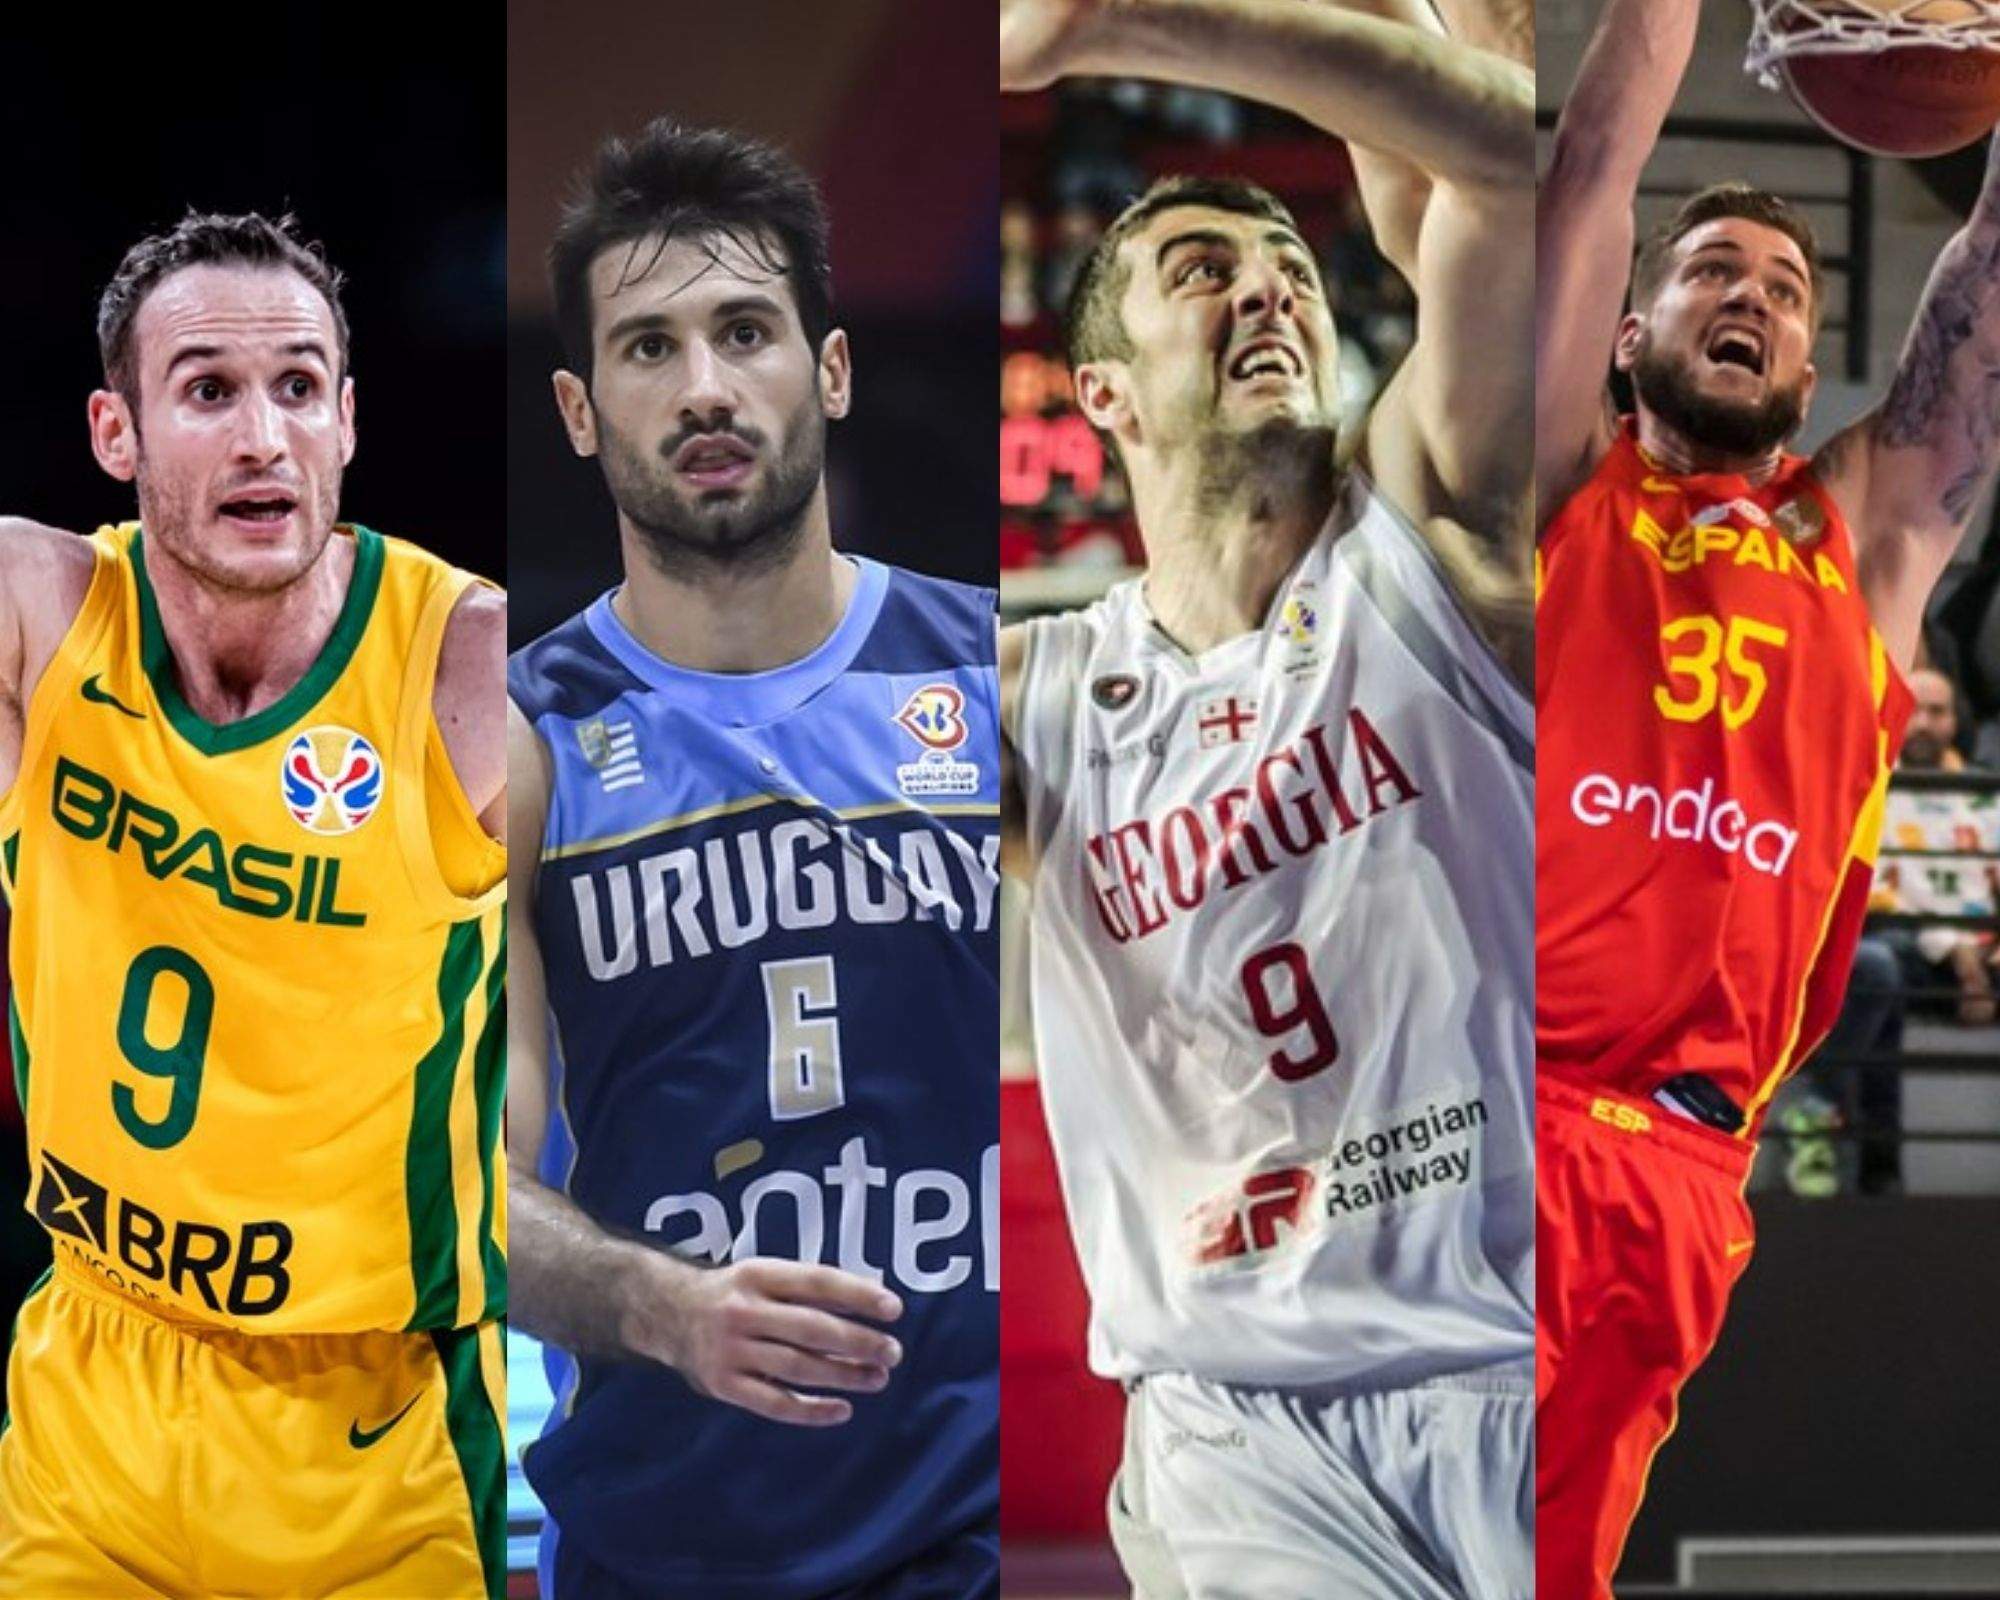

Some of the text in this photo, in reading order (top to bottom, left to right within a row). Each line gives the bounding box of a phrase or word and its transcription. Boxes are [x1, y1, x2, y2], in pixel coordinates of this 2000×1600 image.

[1653, 614, 1787, 731] 35
[52, 755, 366, 927] BRASIL
[1087, 705, 1422, 944] GEORGIA
[570, 818, 1000, 982] URUGUAY
[111, 945, 215, 1150] 9
[760, 955, 845, 1121] 6
[1241, 942, 1339, 1082] 9
[1327, 1147, 1471, 1217] Railway
[1332, 1099, 1489, 1162] eorgian
[1590, 1098, 1651, 1132] ESP
[118, 1197, 293, 1316] BRB
